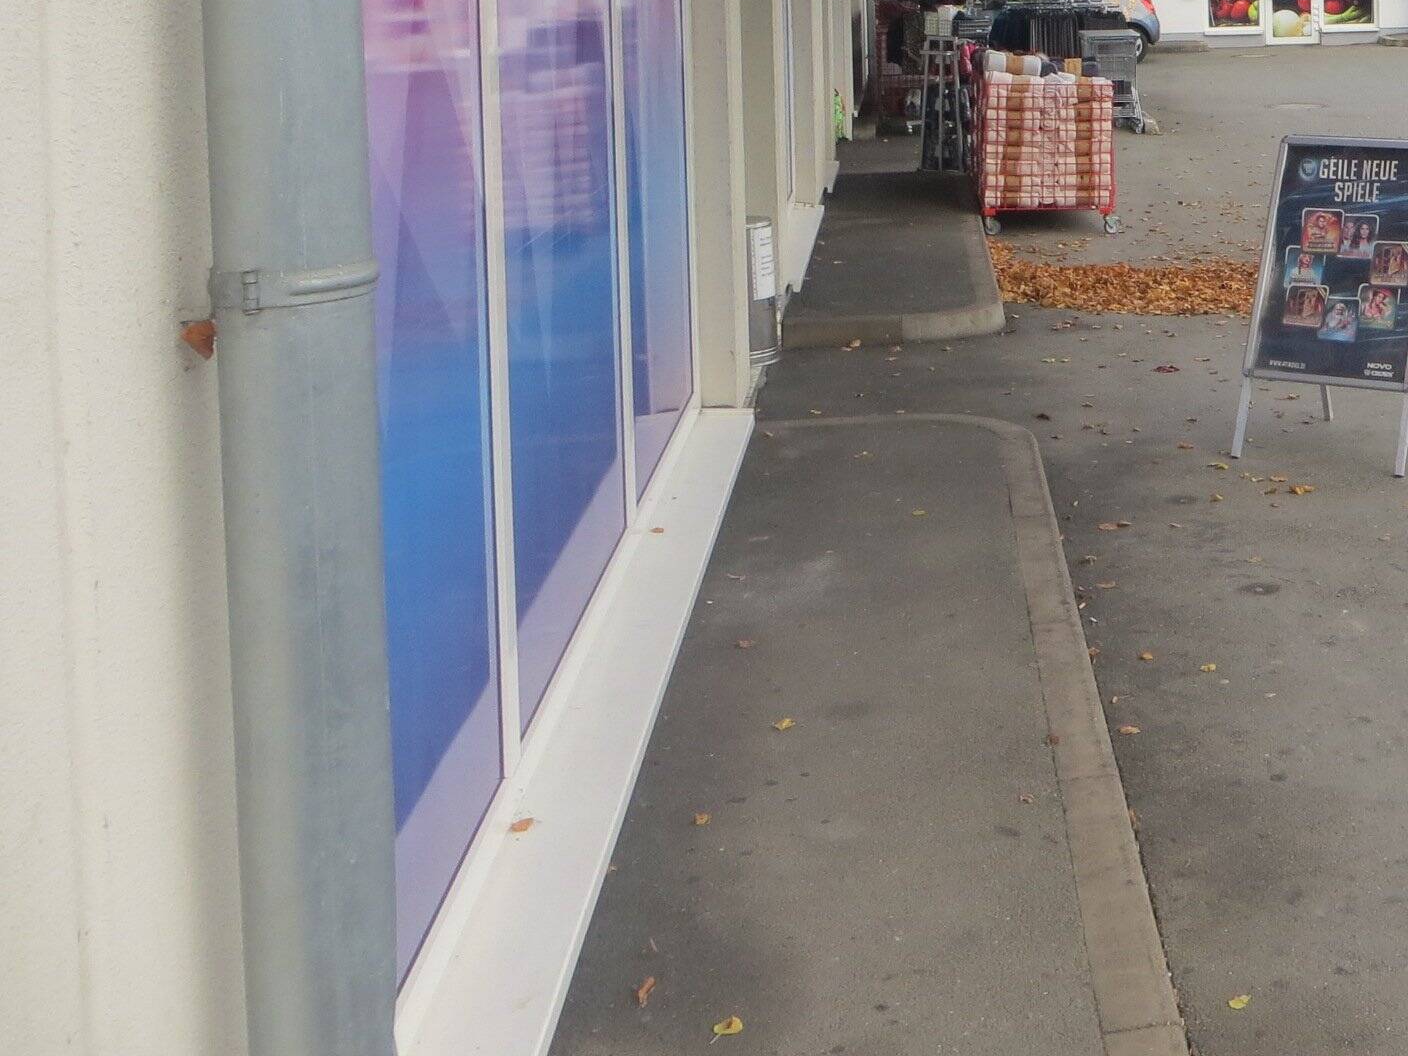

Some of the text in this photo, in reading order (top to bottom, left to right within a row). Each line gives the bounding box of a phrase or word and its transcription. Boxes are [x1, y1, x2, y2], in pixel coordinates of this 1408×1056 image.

[1319, 157, 1399, 181] GEILE NEUE
[1334, 182, 1382, 203] SPIELE
